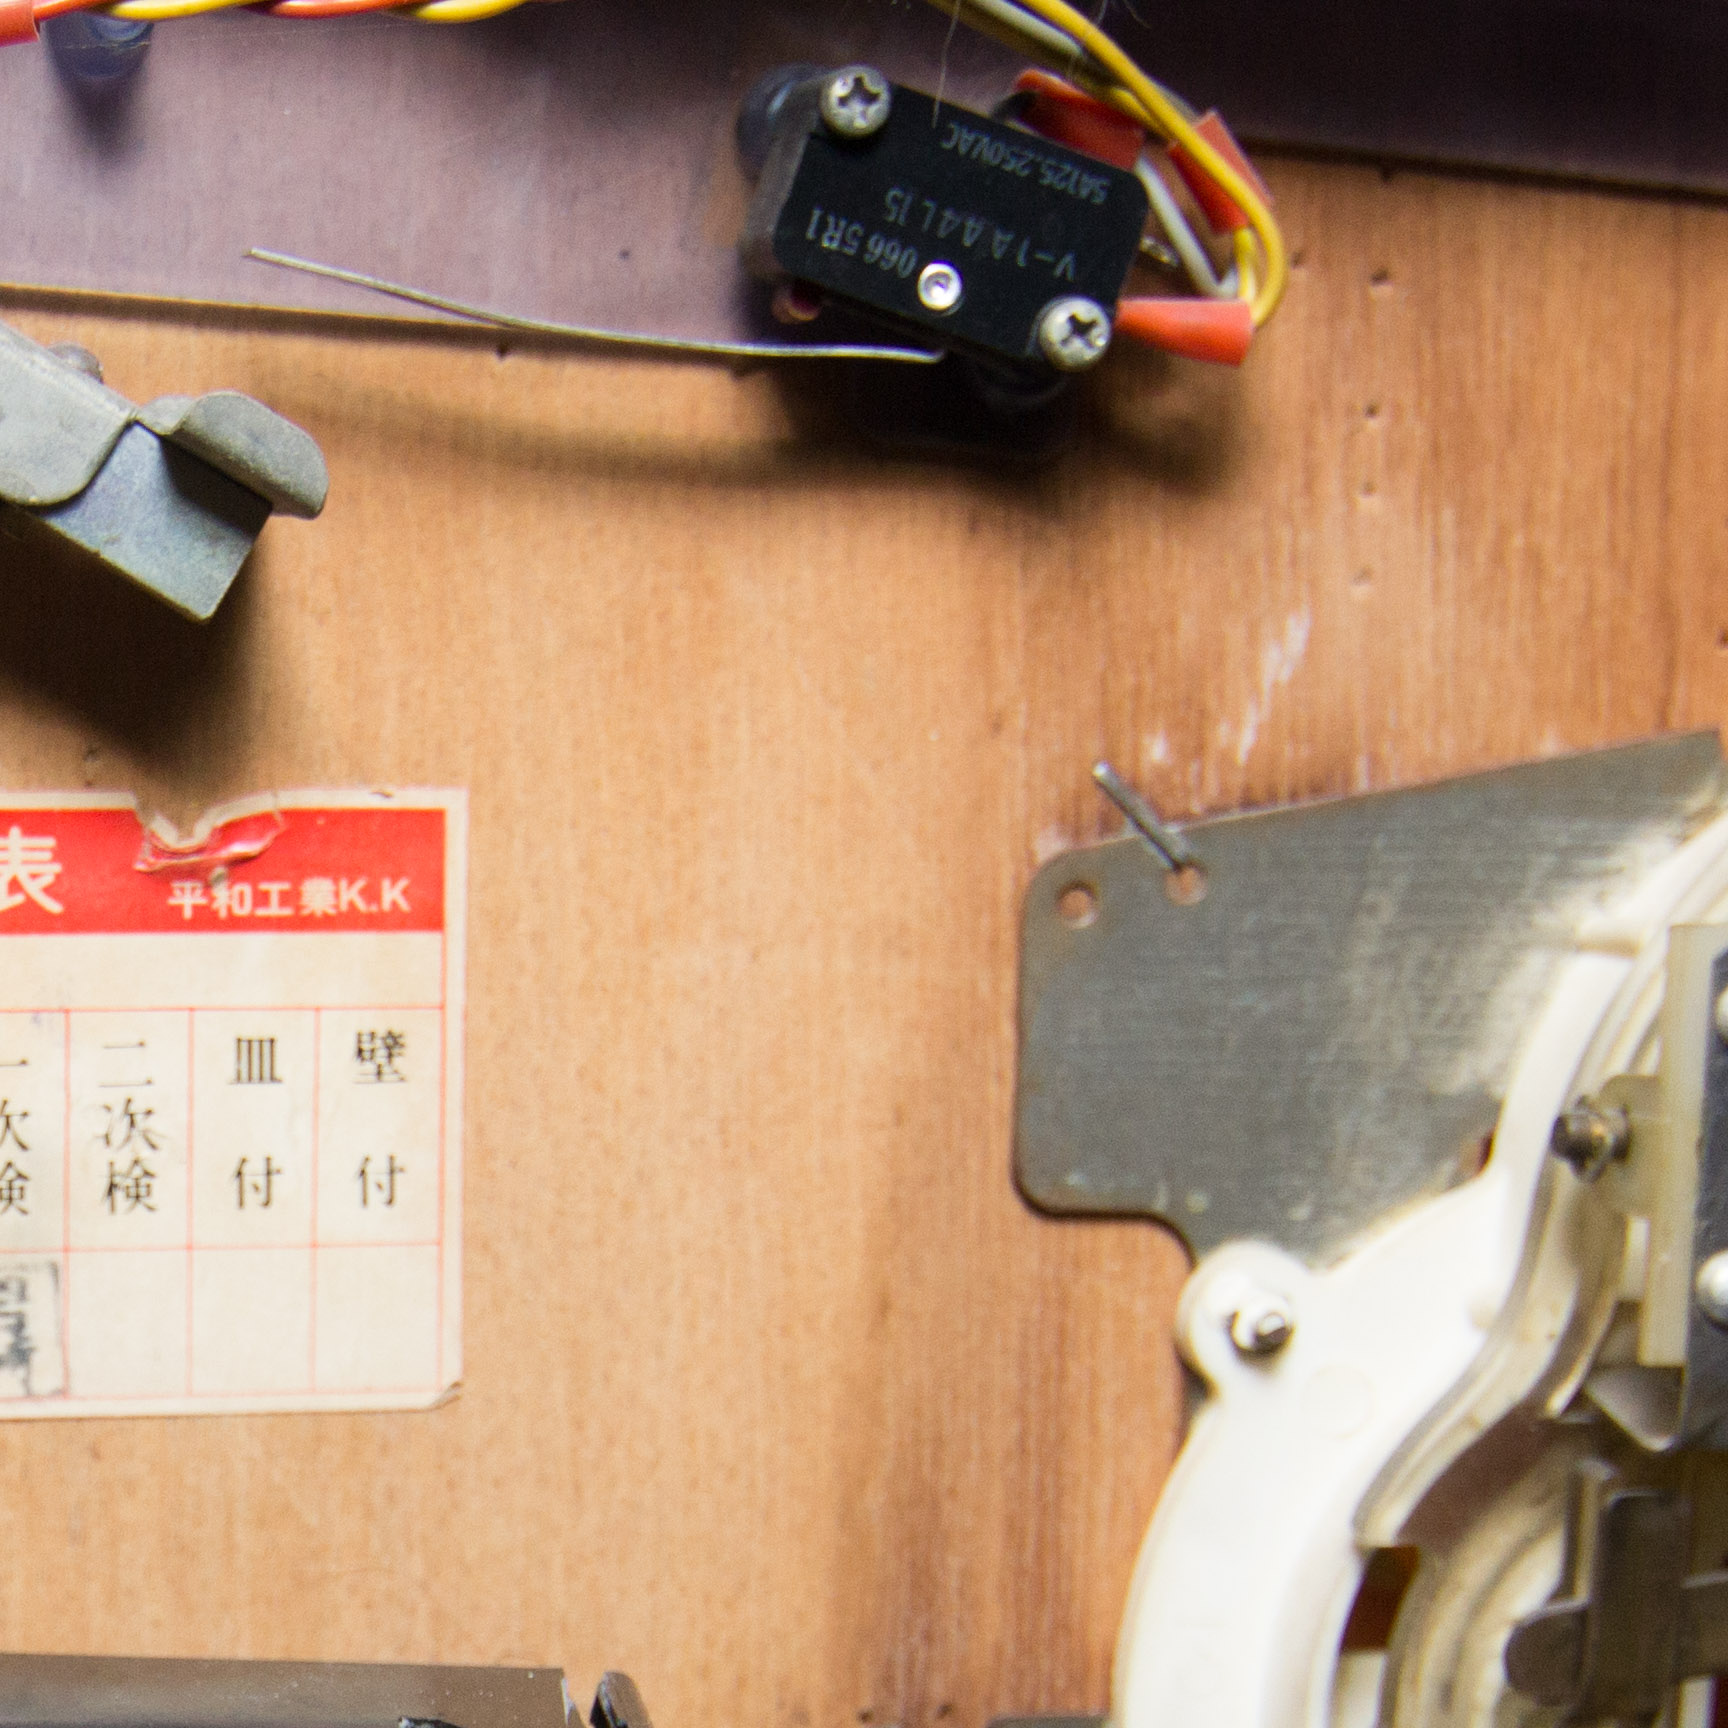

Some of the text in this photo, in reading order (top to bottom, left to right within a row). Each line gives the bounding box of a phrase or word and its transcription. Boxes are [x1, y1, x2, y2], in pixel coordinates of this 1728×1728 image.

[97, 1039, 162, 1216] 二次検
[227, 1035, 285, 1210] 皿付
[351, 1028, 408, 1209] 壁付
